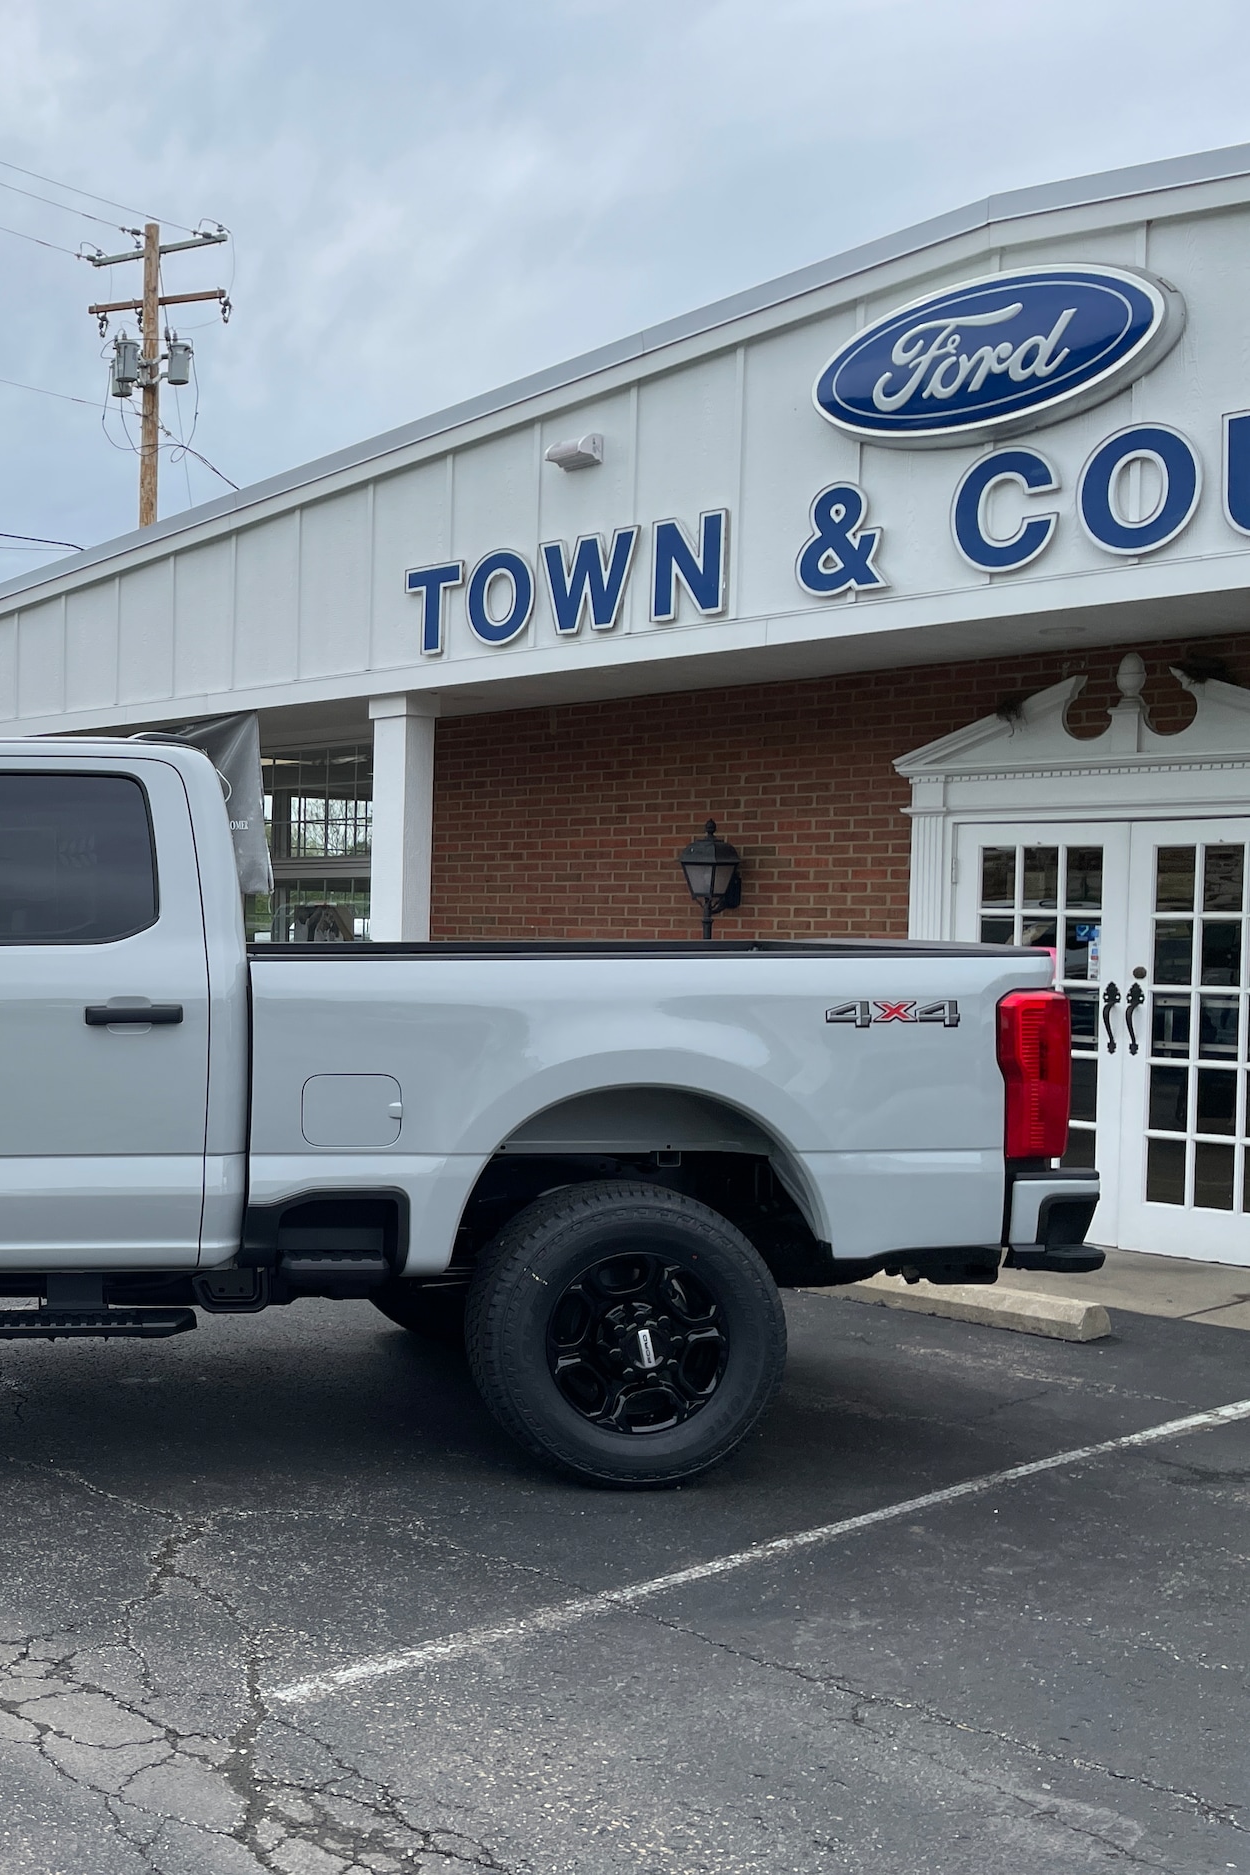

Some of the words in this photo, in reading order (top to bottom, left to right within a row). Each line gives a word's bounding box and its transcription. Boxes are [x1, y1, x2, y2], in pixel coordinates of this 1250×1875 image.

[872, 302, 1078, 412] Ford
[405, 508, 728, 655] TOWN
[795, 481, 892, 597] &
[949, 411, 1250, 573] CO
